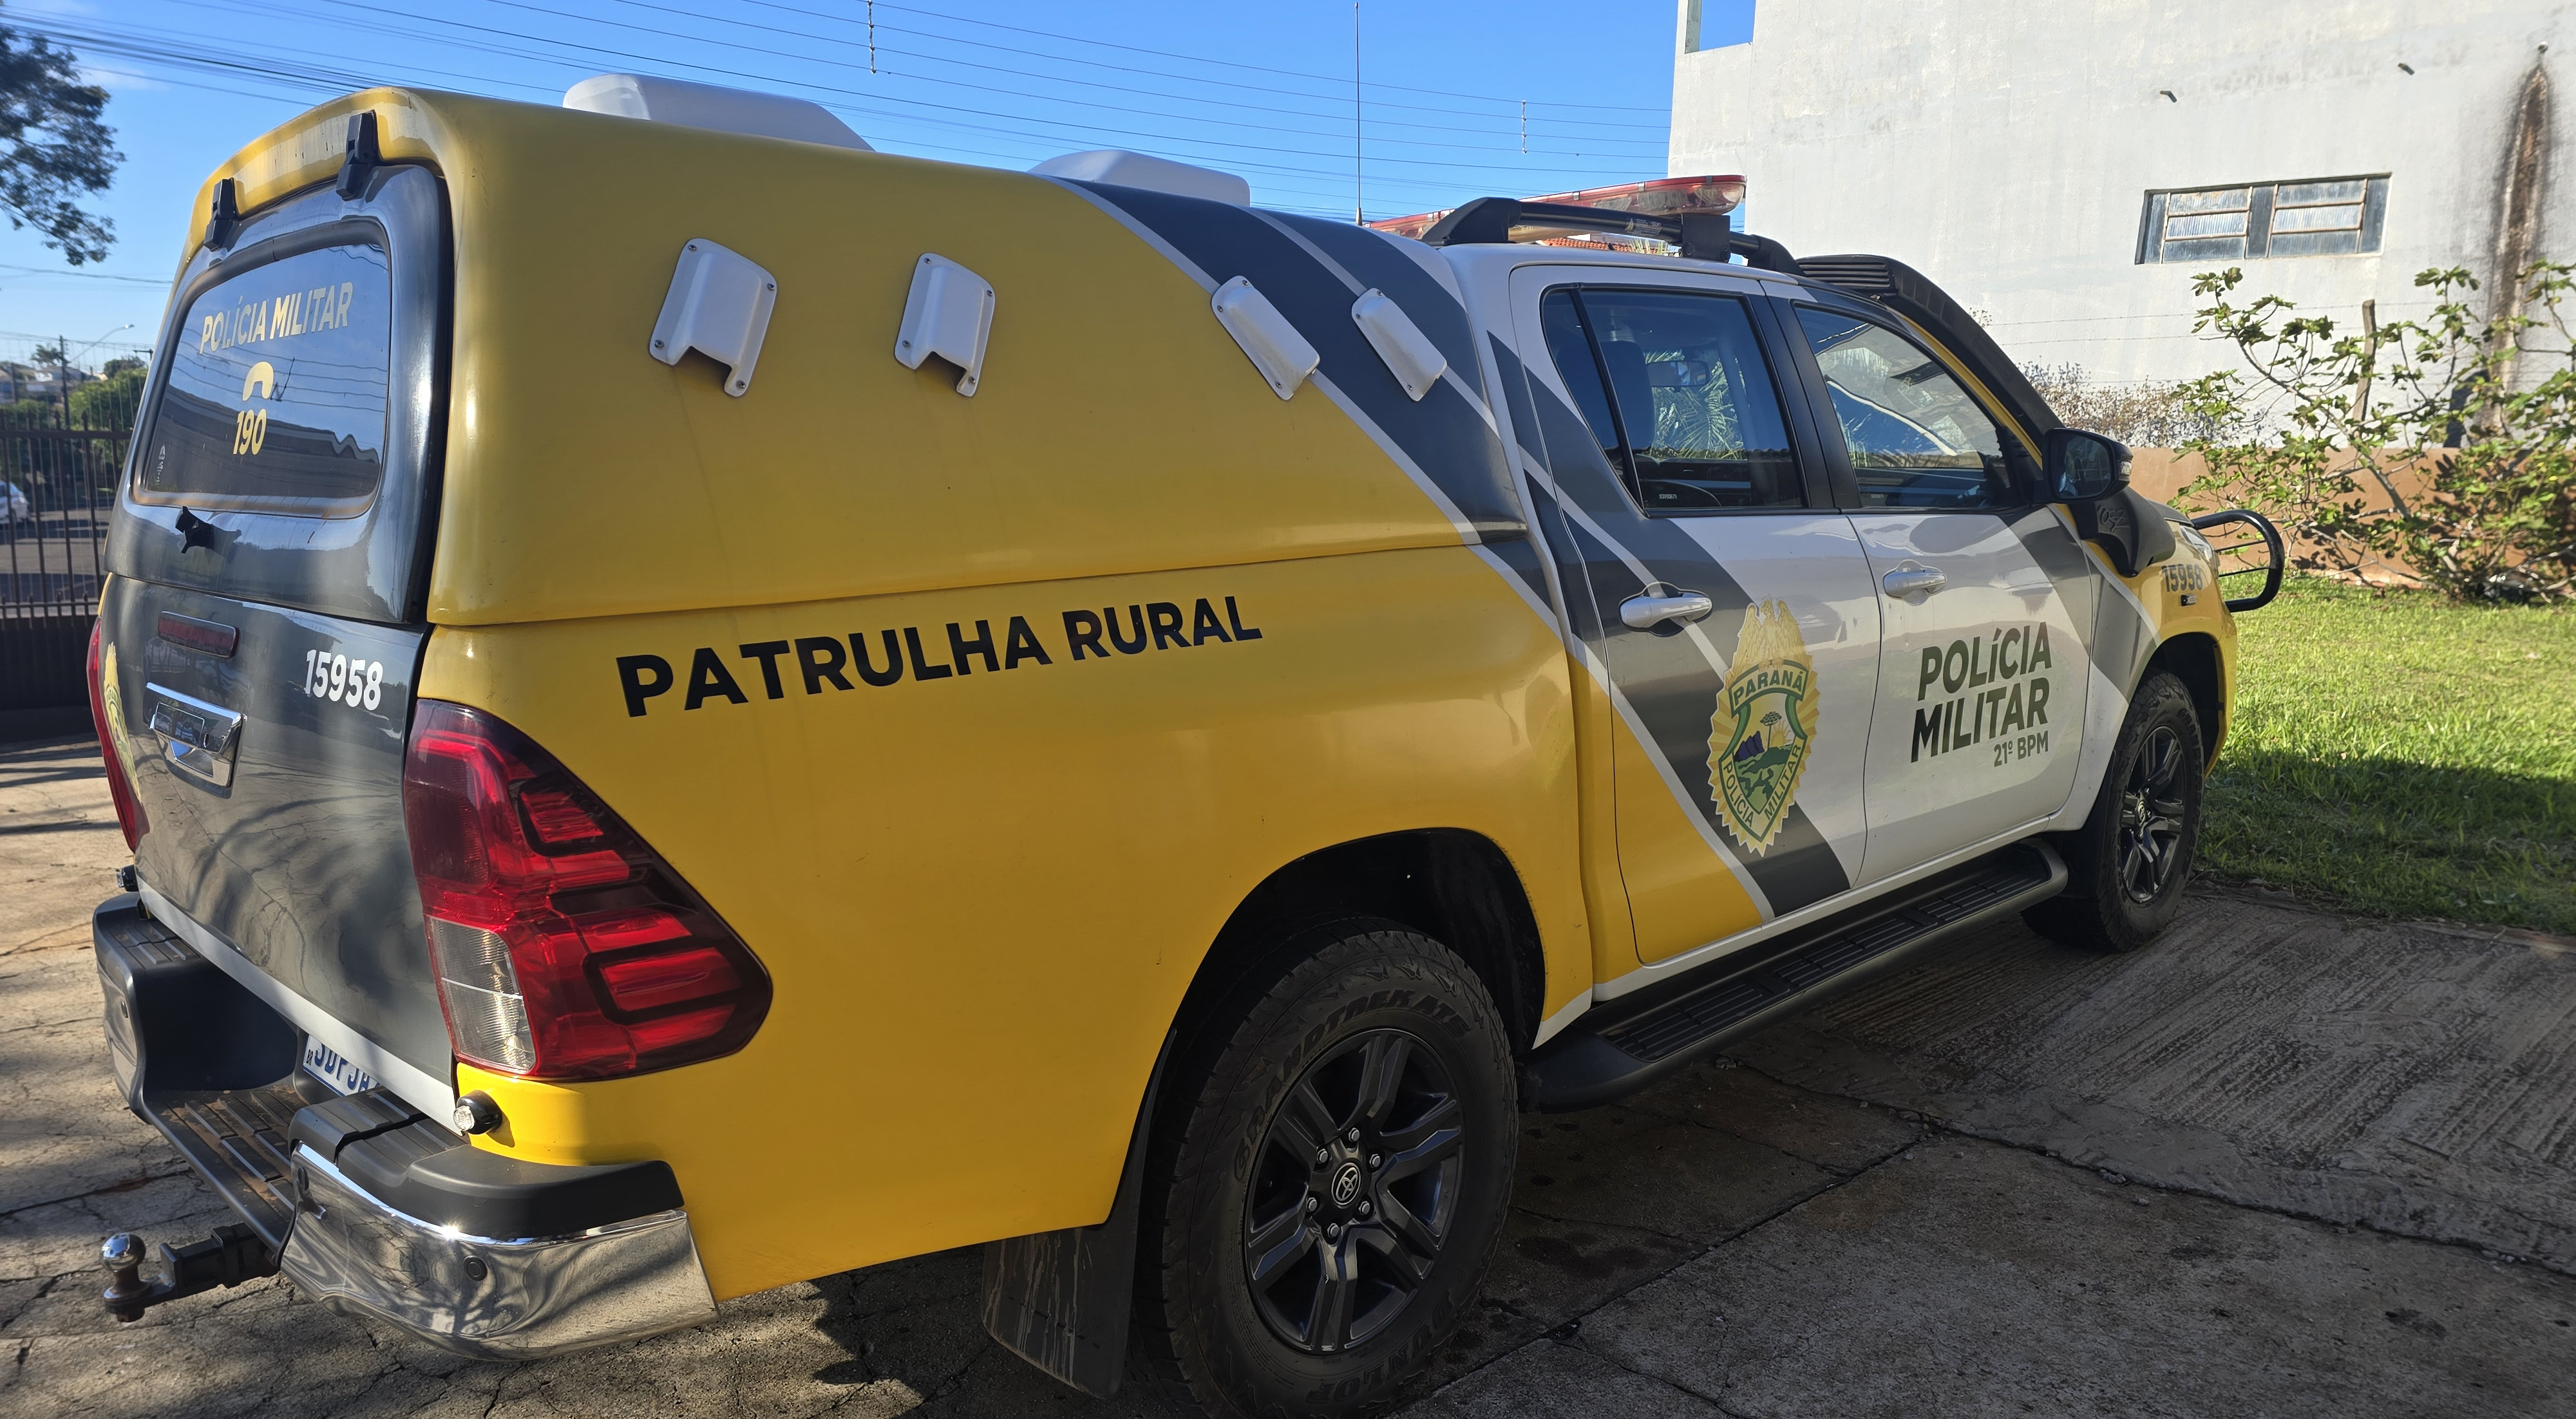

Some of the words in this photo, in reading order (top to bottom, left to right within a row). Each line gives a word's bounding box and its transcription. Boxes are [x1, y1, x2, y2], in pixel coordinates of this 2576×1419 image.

[199, 296, 267, 354] POLÍCIA
[269, 281, 354, 339] MILITAR
[232, 408, 268, 455] 190
[2161, 563, 2203, 592] 15958
[305, 650, 383, 711] 15958
[616, 616, 1053, 717] PATRULHA
[1061, 596, 1263, 661] RURAL
[1732, 670, 1803, 704] PARANÁ
[1917, 621, 2052, 702] POLÍCIA
[1911, 677, 2050, 764] MILITAR
[2018, 731, 2049, 760] BPM
[1723, 760, 1754, 828] POLÍCIA
[1765, 744, 1801, 821] MILITAR
